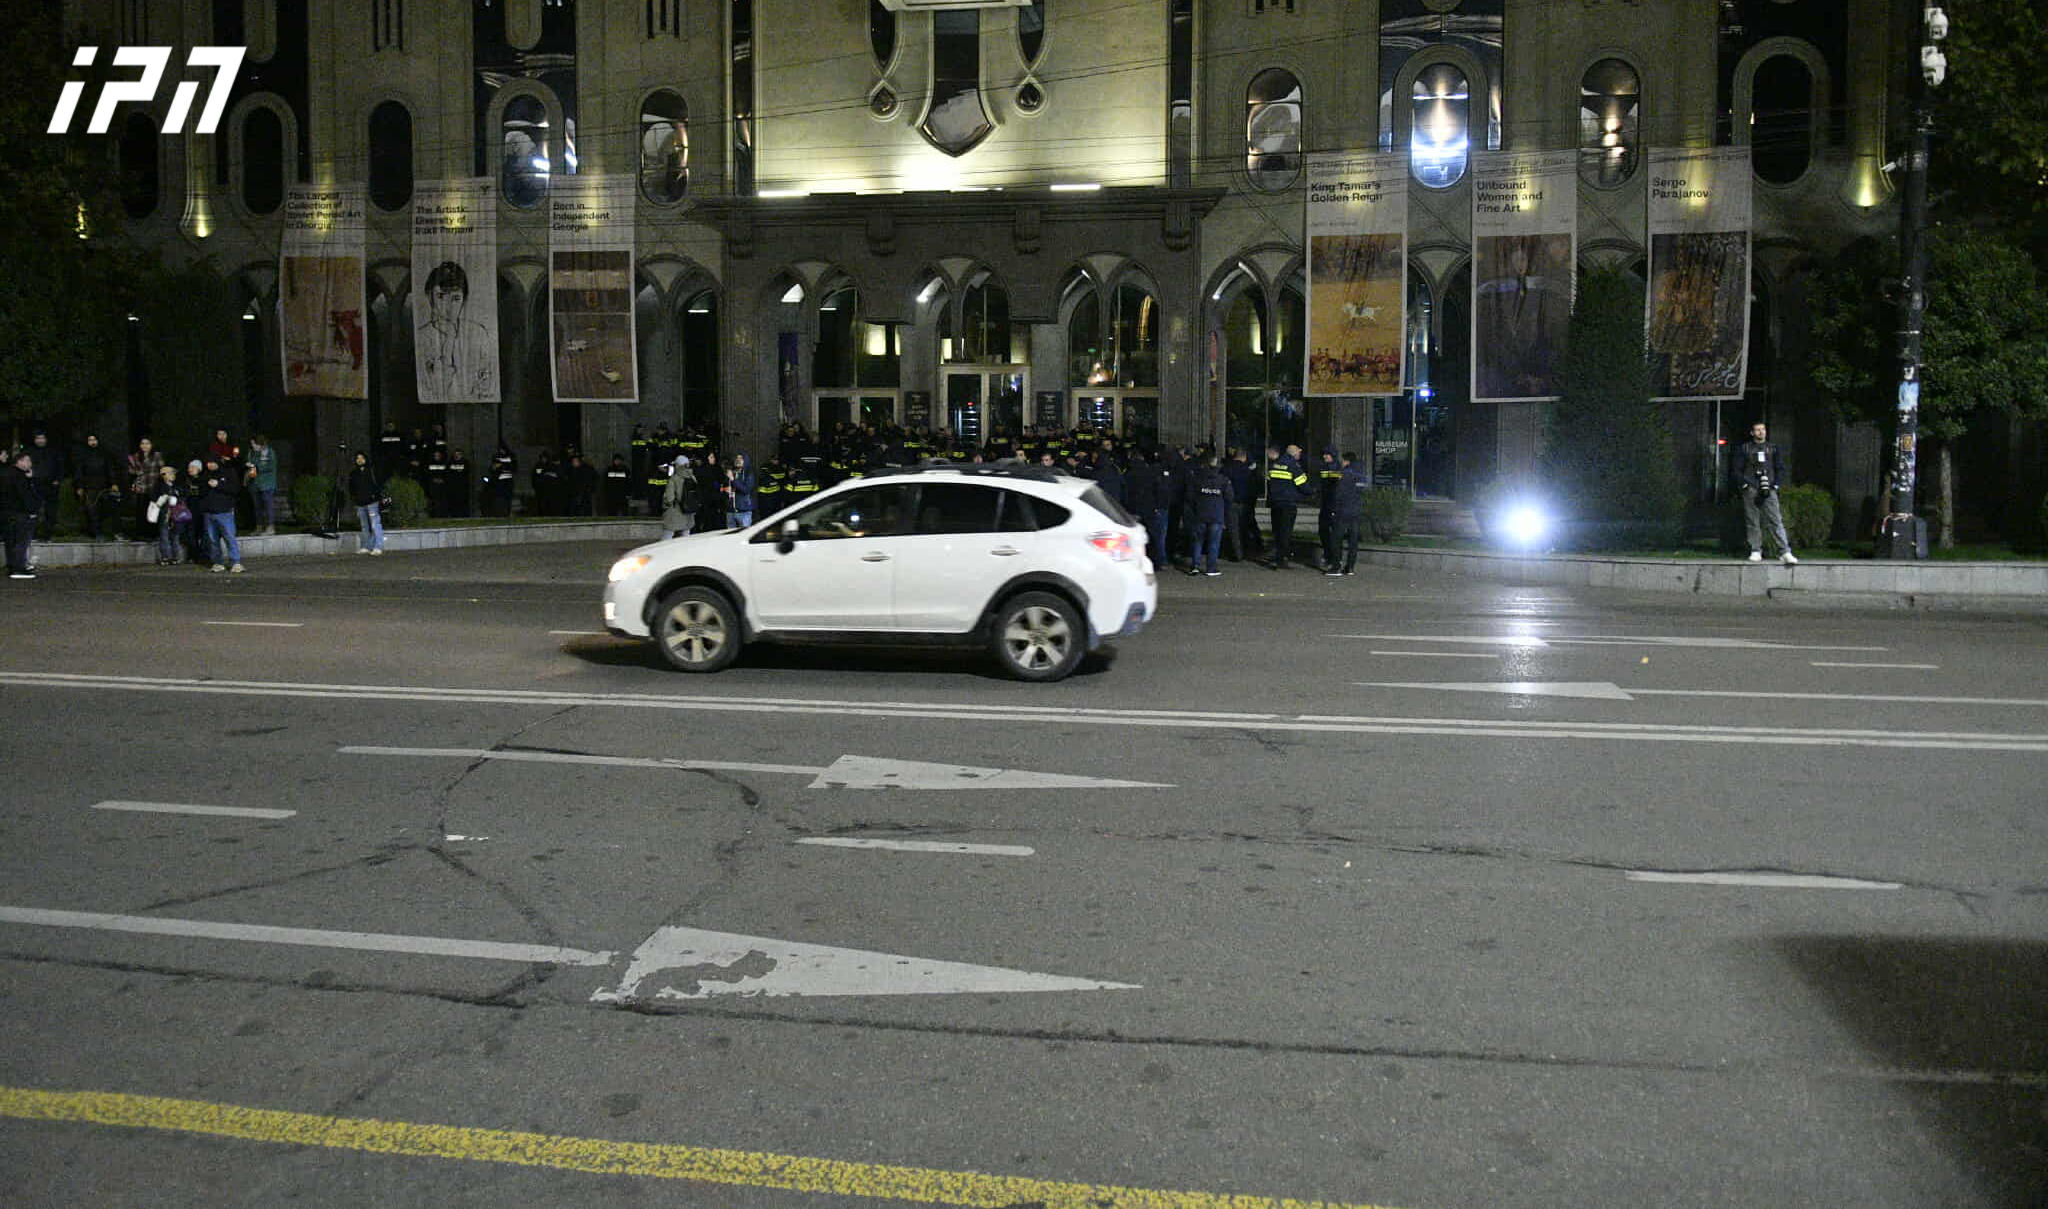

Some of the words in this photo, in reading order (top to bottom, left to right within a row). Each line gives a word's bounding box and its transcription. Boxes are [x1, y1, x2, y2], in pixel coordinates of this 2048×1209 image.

[1477, 181, 1526, 190] Unbound
[1653, 176, 1687, 188] Sergo
[1311, 183, 1335, 193] King
[1311, 194, 1349, 202] Golden
[1353, 192, 1383, 203] Reign
[1477, 193, 1518, 202] Women
[1653, 189, 1708, 200] Parajanov
[1477, 204, 1501, 213] Fine
[1504, 204, 1521, 213] Art
